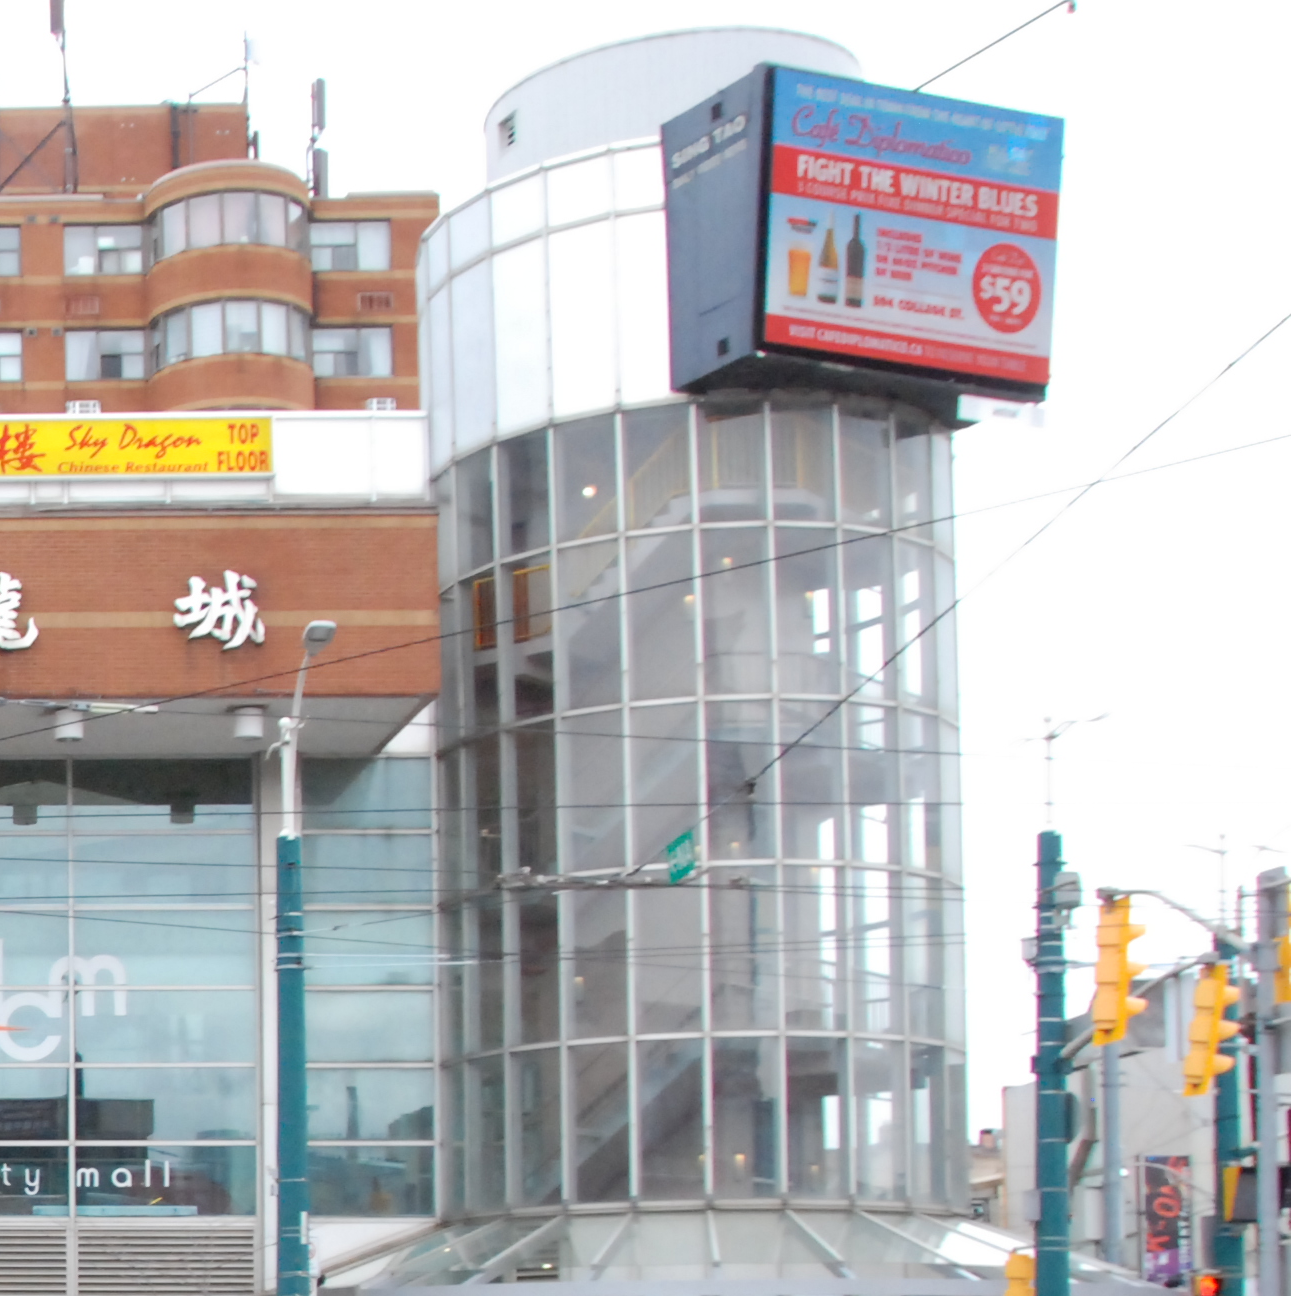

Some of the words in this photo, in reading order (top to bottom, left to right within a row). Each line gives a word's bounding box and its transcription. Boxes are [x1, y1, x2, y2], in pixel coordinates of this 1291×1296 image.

[797, 154, 854, 185] FIGHT
[859, 165, 895, 193] THE
[899, 172, 974, 206] WINTER
[978, 187, 1038, 217] BLUES
[980, 274, 1032, 316] $59
[65, 425, 108, 459] Sky
[119, 423, 203, 460] Dragon
[227, 423, 260, 444] TOP
[57, 461, 120, 474] Chinese
[125, 461, 209, 474] Restaurant
[217, 451, 270, 472] FLOOR
[75, 1159, 172, 1188] mall
